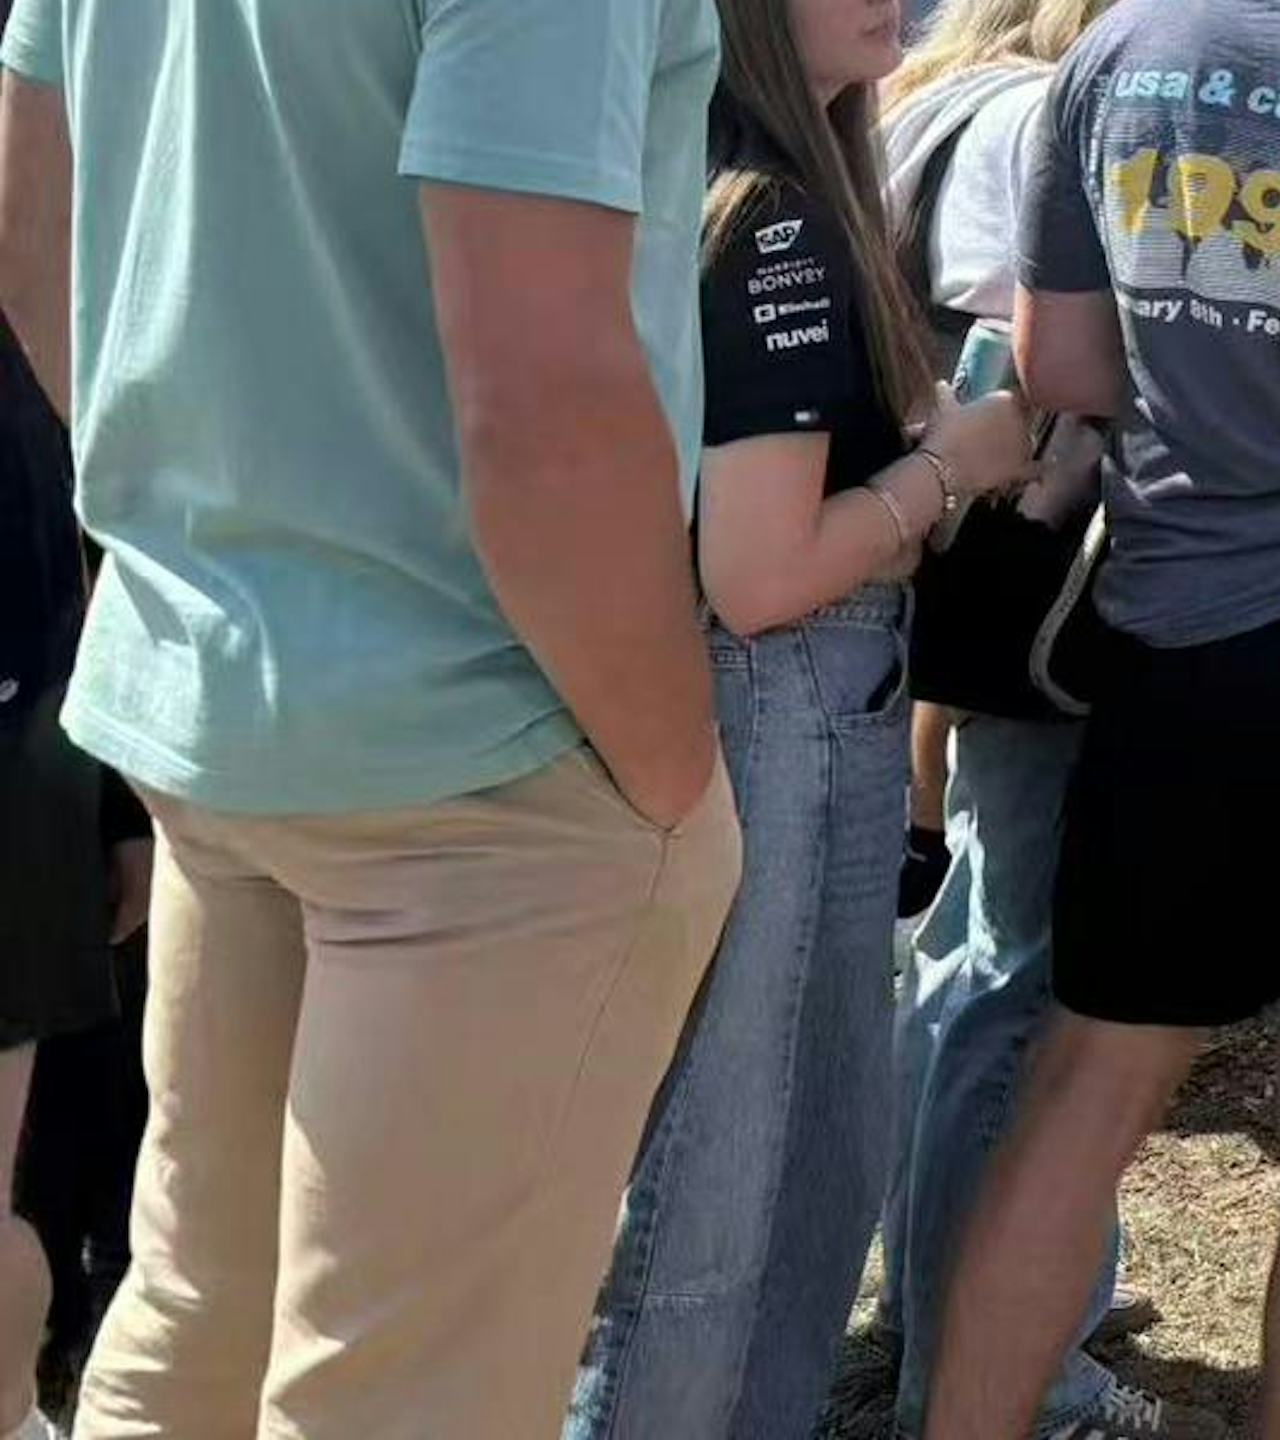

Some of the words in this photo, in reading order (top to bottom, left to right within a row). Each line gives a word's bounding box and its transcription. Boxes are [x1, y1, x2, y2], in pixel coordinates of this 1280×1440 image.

[1115, 69, 1190, 98] usa
[1199, 68, 1237, 106] &
[1134, 300, 1184, 323] ary
[766, 318, 830, 352] nuvei
